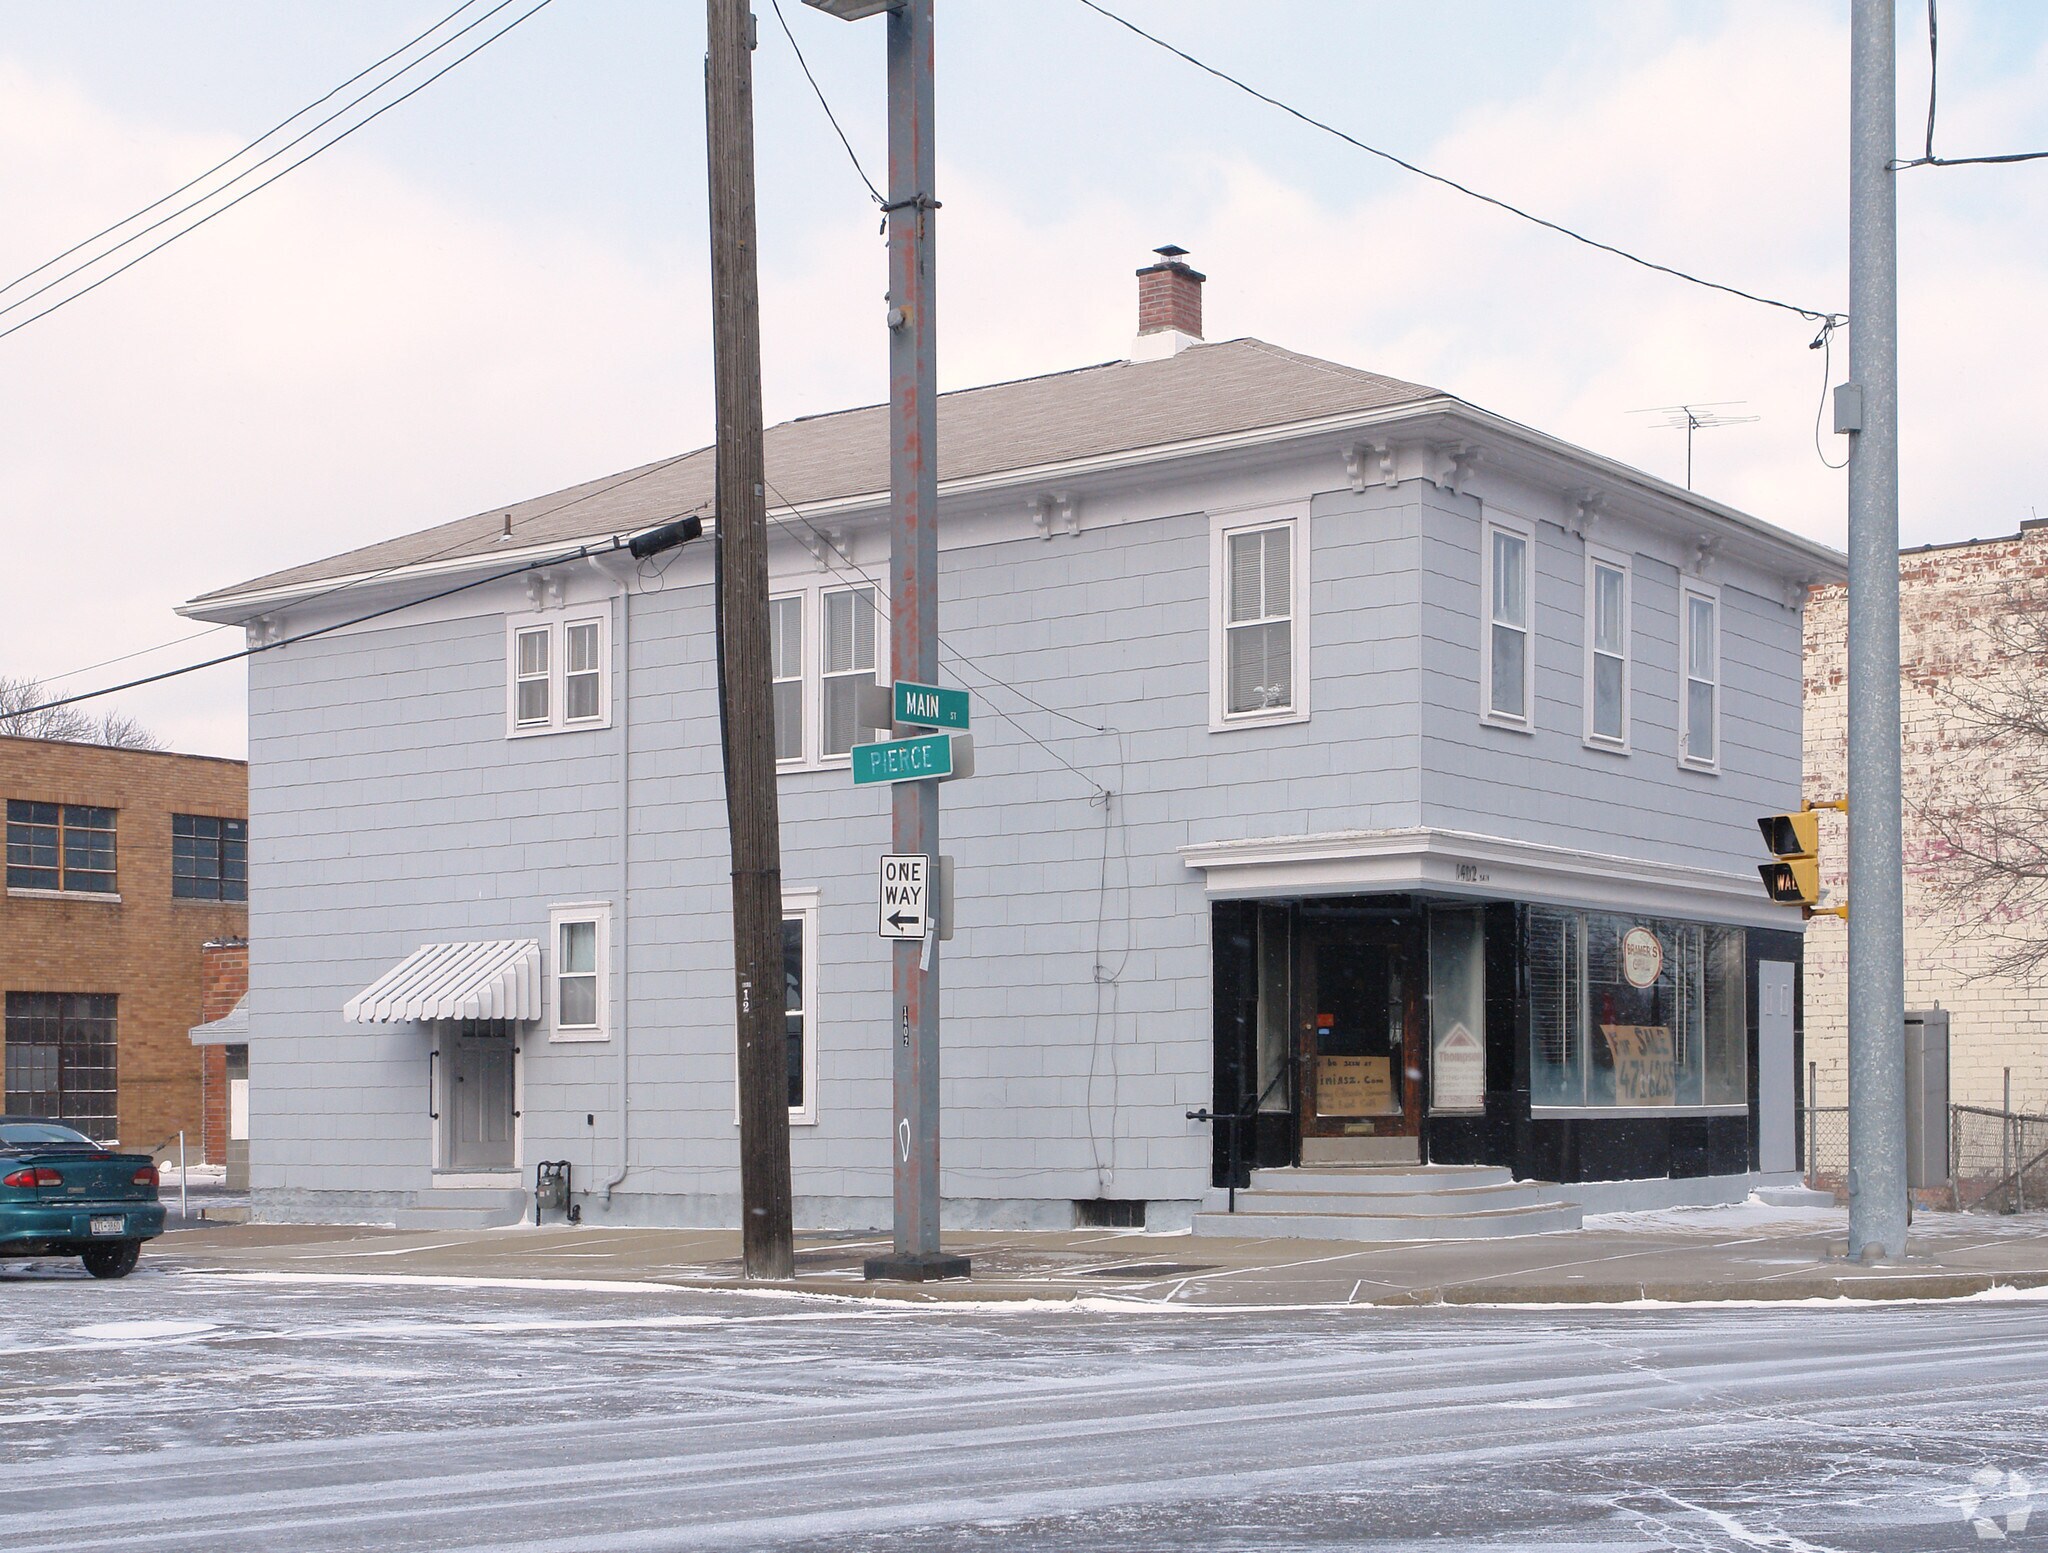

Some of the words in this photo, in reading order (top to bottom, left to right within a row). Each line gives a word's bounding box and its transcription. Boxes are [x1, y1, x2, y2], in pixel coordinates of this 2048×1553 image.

[906, 692, 939, 718] MAIN
[950, 711, 957, 721] ST
[870, 745, 932, 774] PIERCE
[885, 862, 921, 881] ONE
[1776, 873, 1798, 891] WAL
[885, 886, 922, 905] WAY
